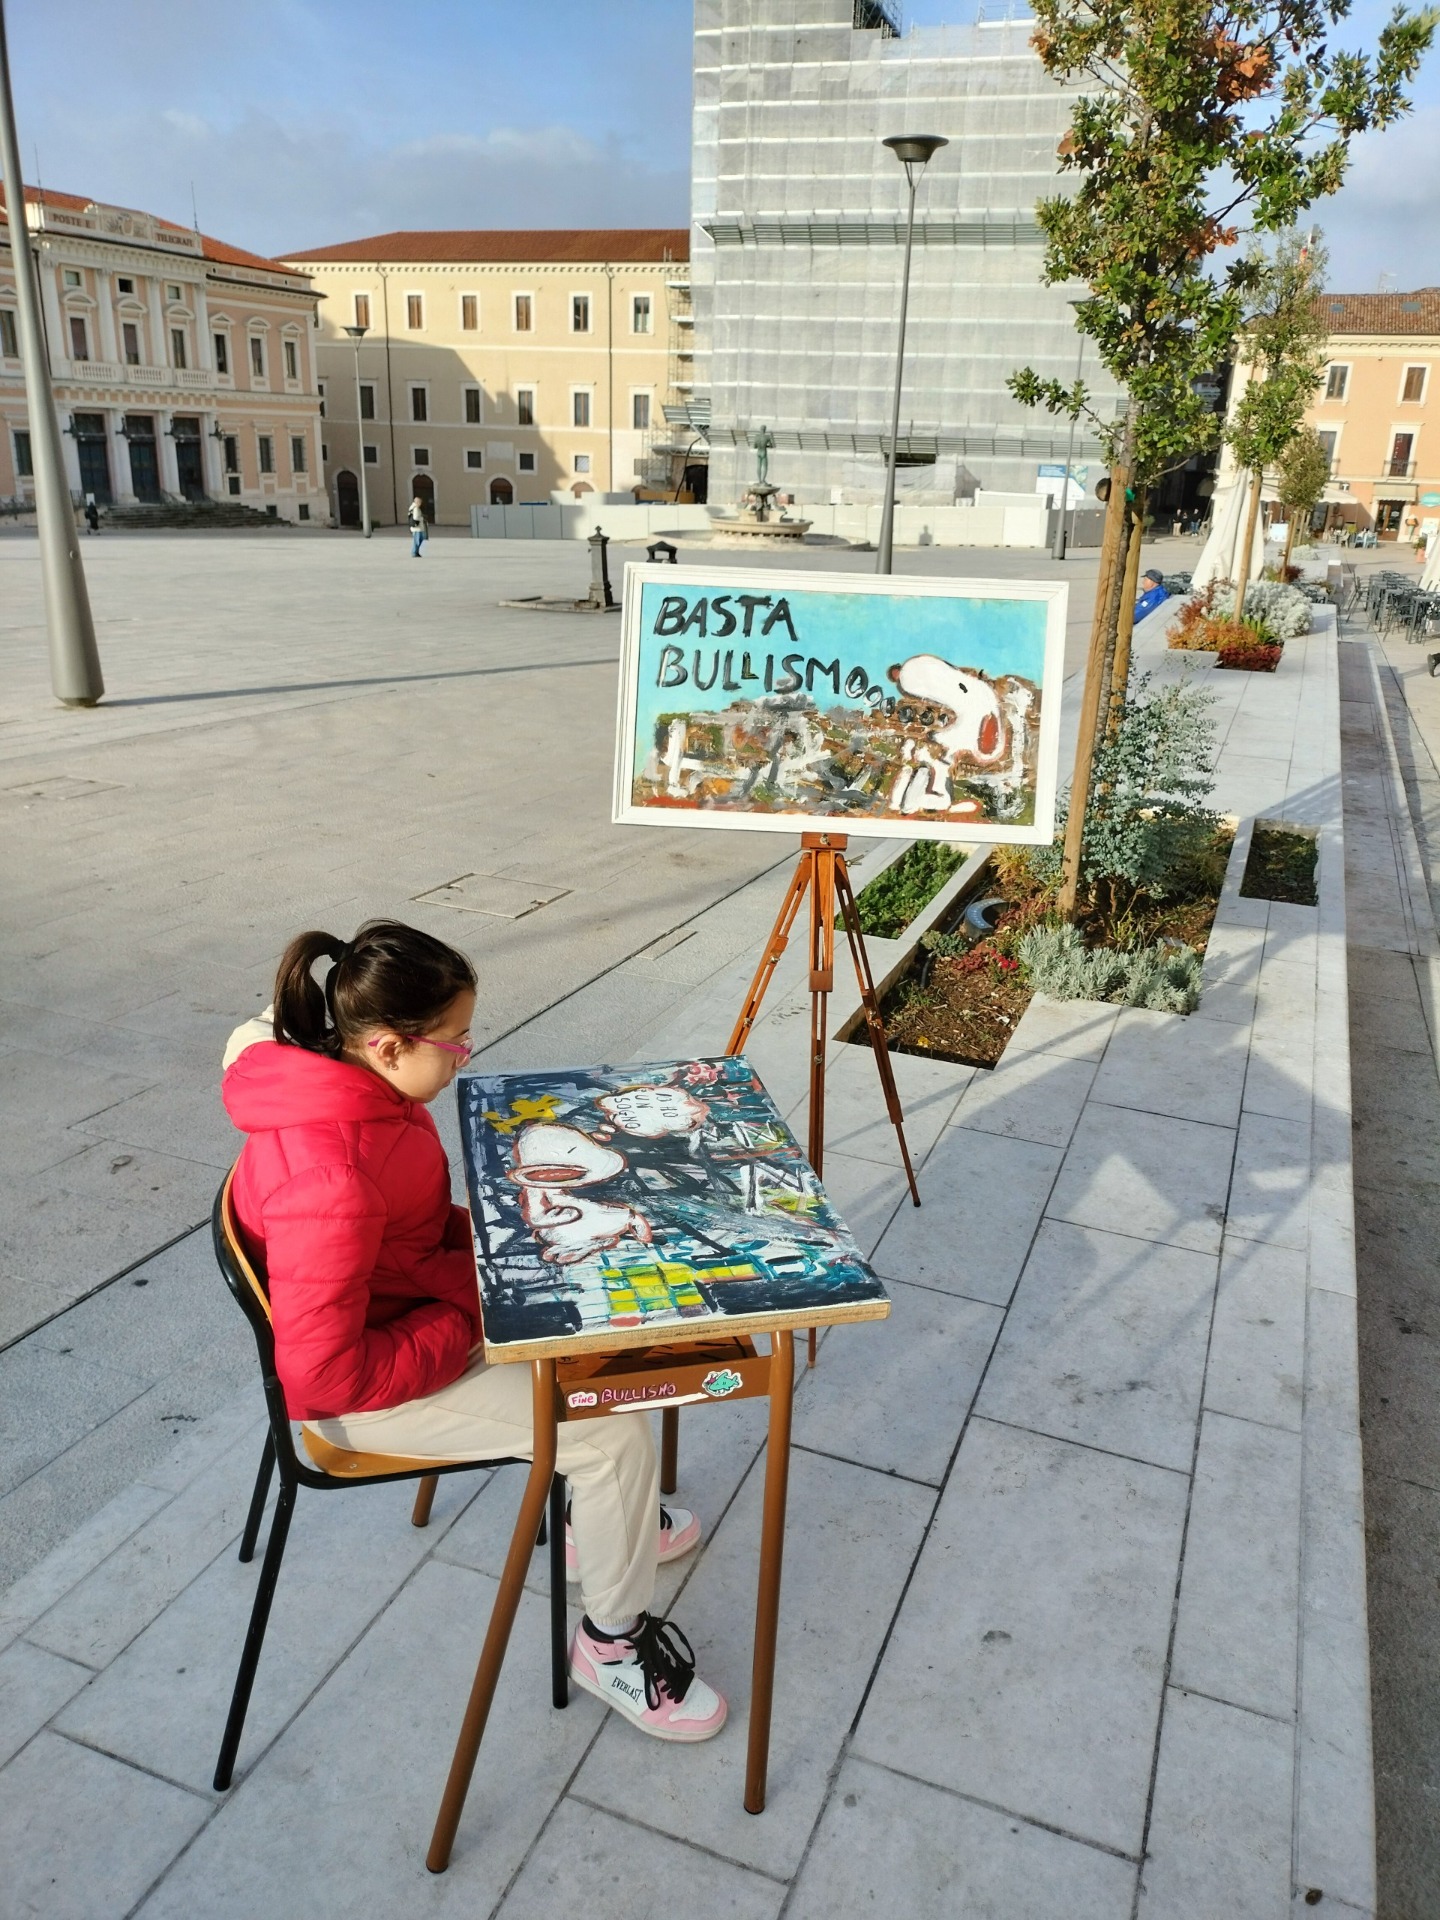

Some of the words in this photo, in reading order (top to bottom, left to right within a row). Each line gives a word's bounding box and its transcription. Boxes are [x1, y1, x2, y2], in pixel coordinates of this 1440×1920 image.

[53, 213, 81, 227] POSTE
[85, 219, 91, 229] E
[653, 595, 799, 642] BASTA
[614, 1097, 641, 1129] SOGNO
[601, 1382, 676, 1403] BULLISMO
[611, 1676, 643, 1703] EVERLAST
